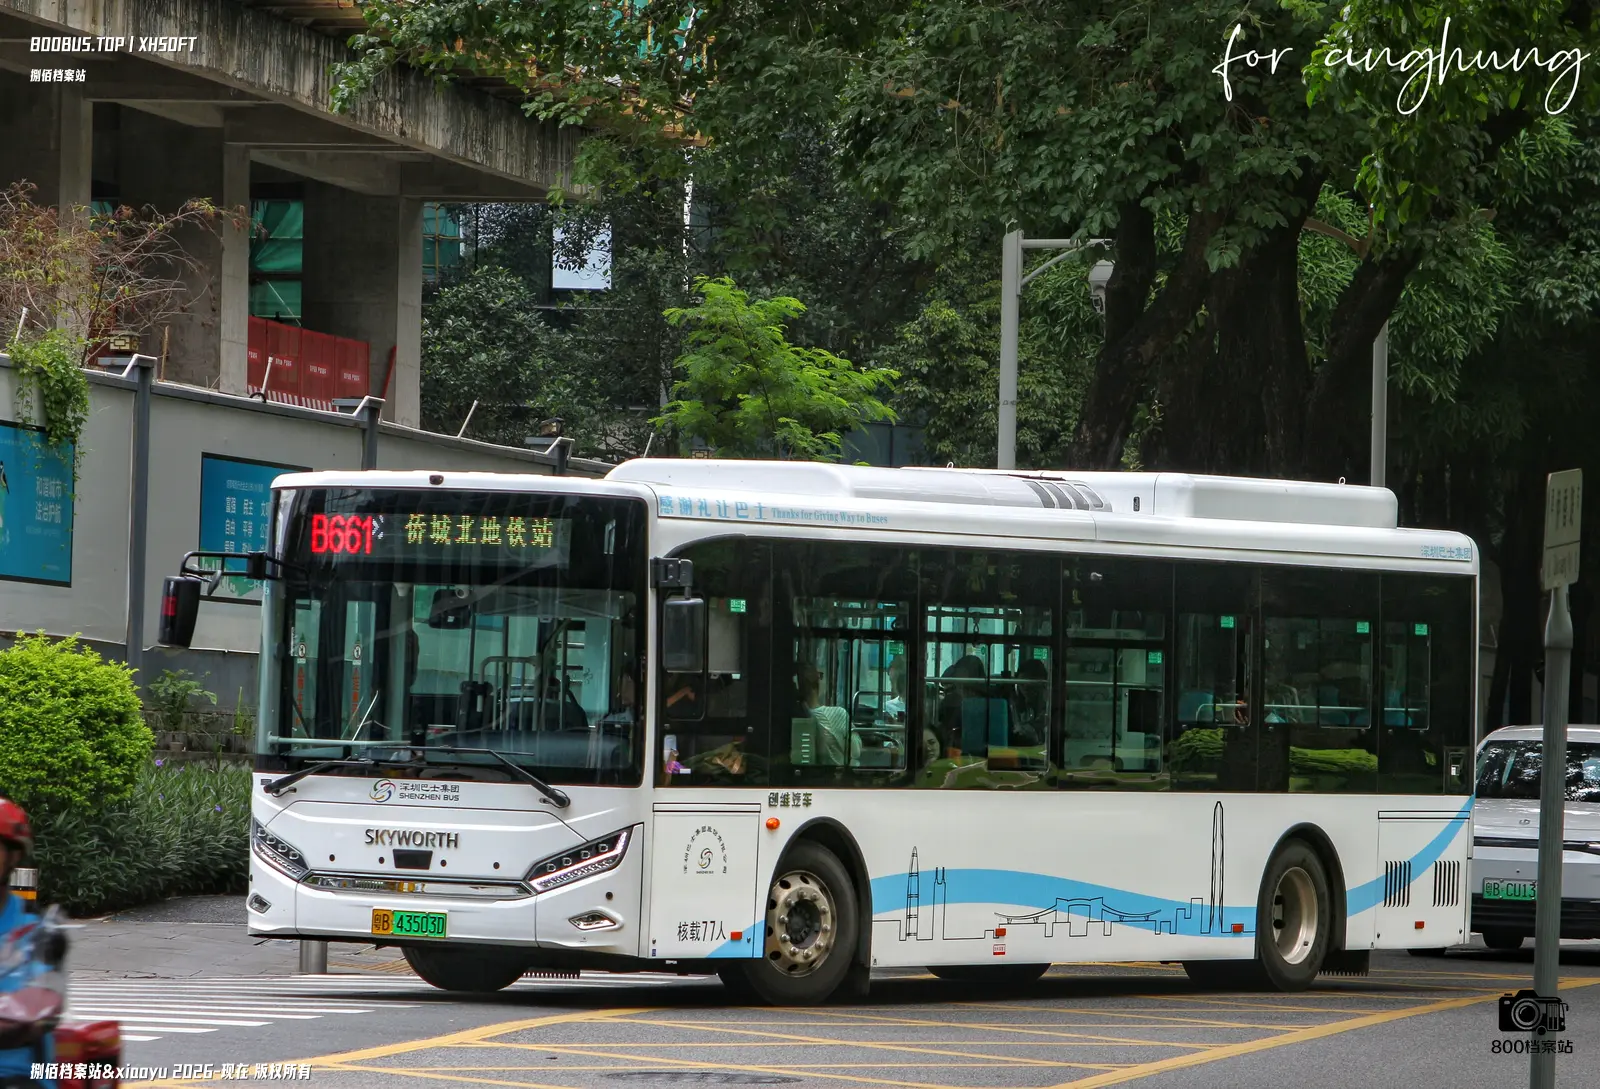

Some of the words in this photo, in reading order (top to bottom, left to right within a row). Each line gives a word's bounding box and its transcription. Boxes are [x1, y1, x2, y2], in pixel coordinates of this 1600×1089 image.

[659, 495, 768, 520] 感谢礼让巴士
[771, 507, 799, 520] Thanks
[800, 509, 812, 520] for
[814, 510, 839, 523] Giving
[839, 511, 855, 524] Way
[855, 513, 865, 523] to
[866, 512, 888, 524] Buses
[311, 513, 373, 554] B661
[405, 512, 554, 549] 侨城北地铁站
[1421, 545, 1471, 559] 深圳巴士集团
[399, 792, 441, 801] SHENZHEN
[400, 782, 460, 793] 深圳巴士集团
[768, 791, 813, 808] 创维汽车
[365, 828, 459, 849] SKYWORTH
[677, 920, 727, 942] 核载77人
